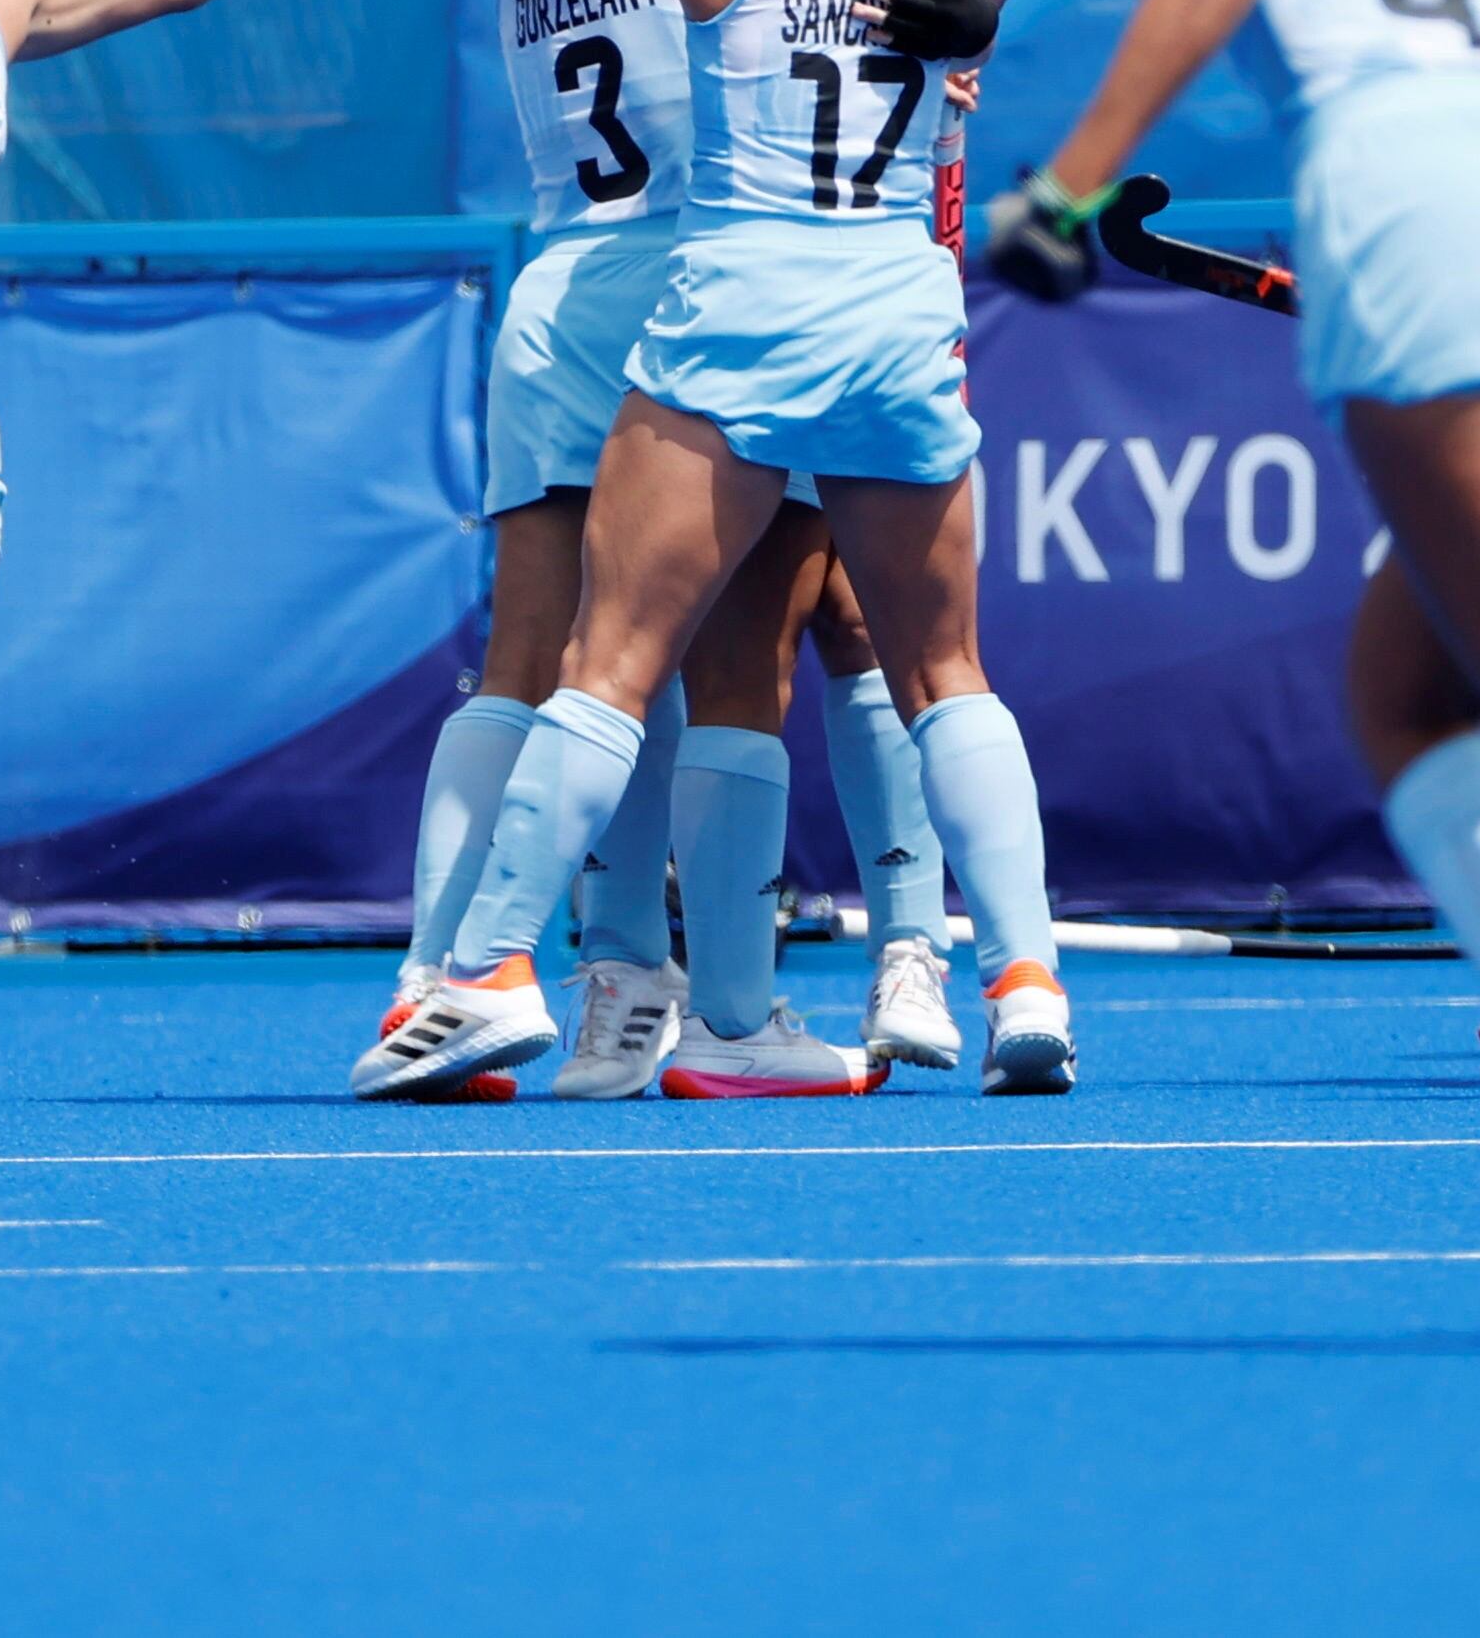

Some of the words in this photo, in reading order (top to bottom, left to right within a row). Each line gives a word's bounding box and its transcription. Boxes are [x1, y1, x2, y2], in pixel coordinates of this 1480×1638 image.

[554, 34, 651, 203] 3
[789, 51, 925, 210] 17
[971, 433, 1318, 584] KYO
